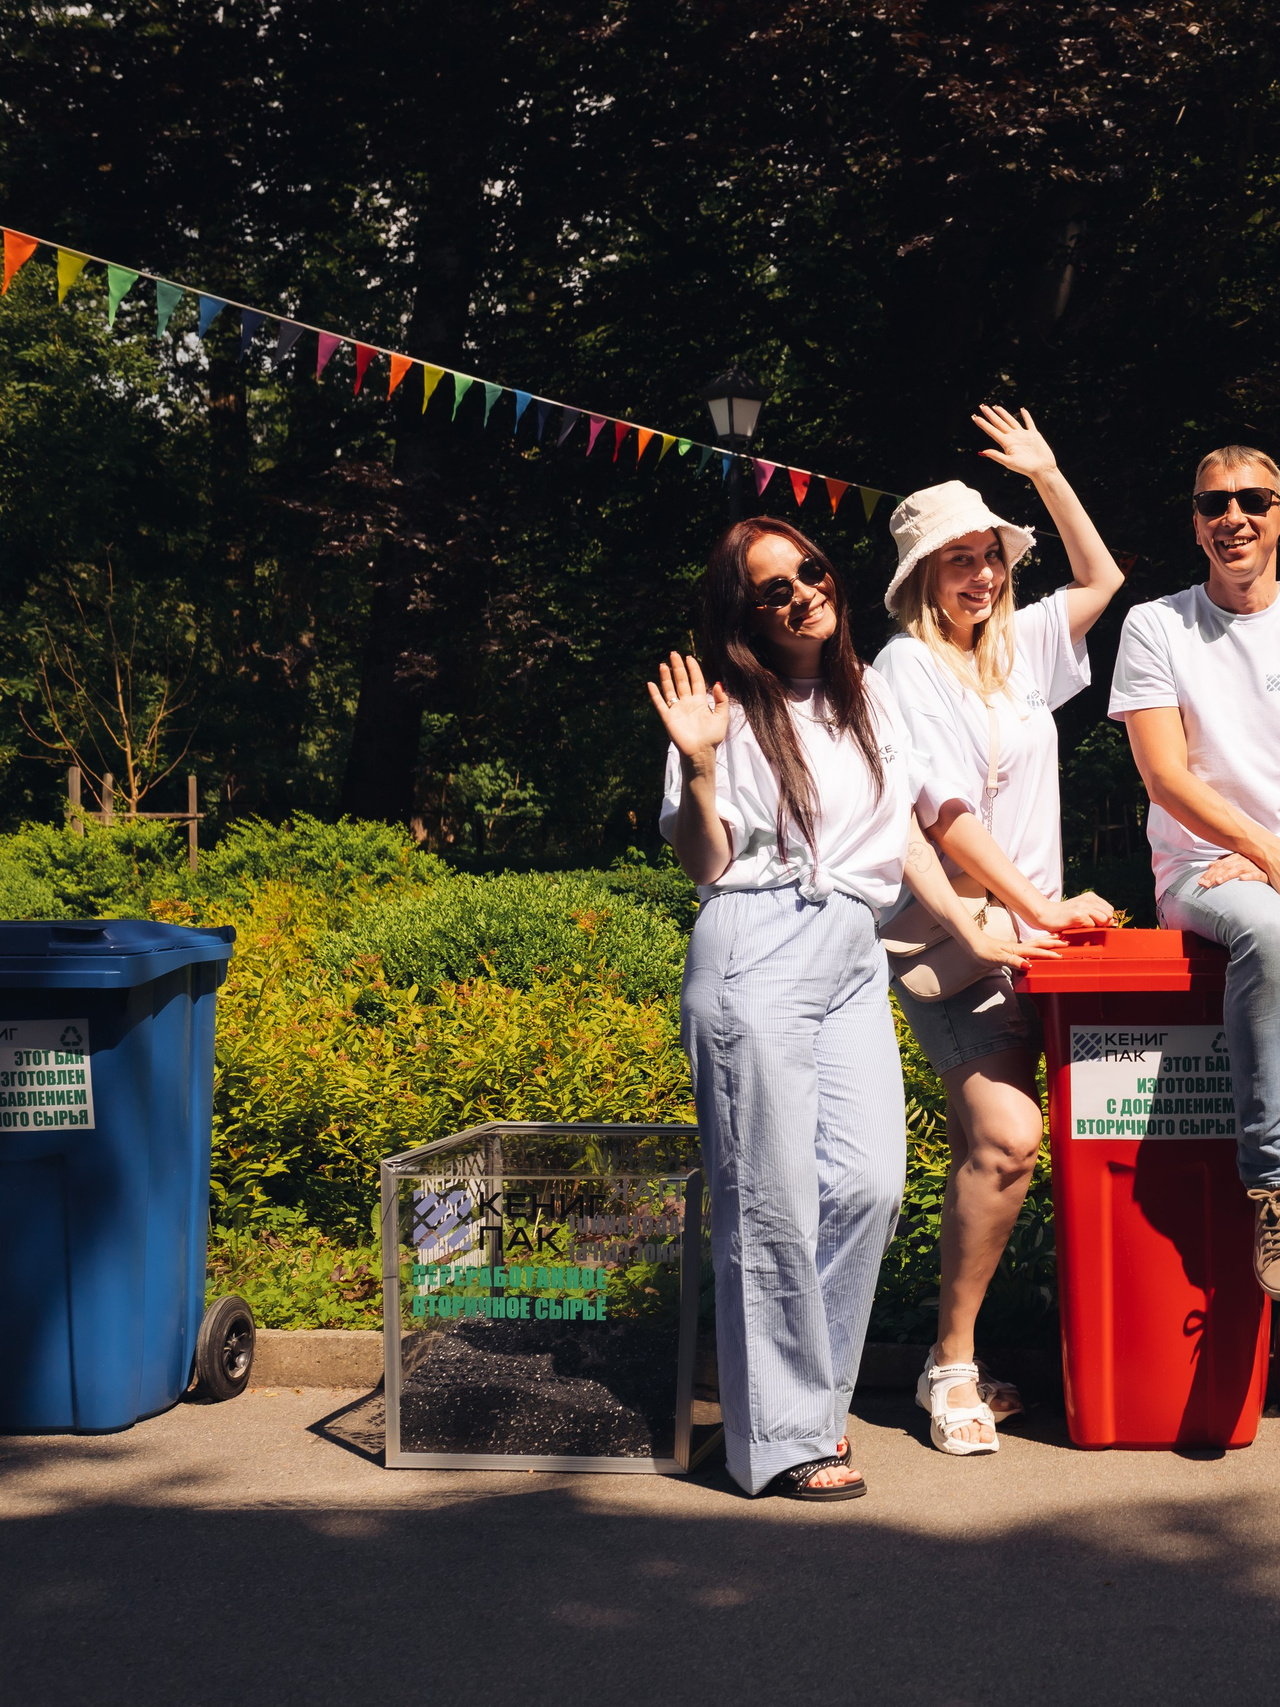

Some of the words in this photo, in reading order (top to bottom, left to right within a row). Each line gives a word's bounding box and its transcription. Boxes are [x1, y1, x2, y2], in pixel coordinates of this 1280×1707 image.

[1105, 1033, 1169, 1046] КЕНИГ
[14, 1050, 51, 1066] ЭТОТ
[54, 1049, 85, 1065] БАК
[1105, 1050, 1146, 1062] ПАК
[1163, 1056, 1201, 1072] ЭТОТ
[0, 1069, 86, 1087] ЗГОТОВЛЕН
[1137, 1077, 1233, 1094] ИЗГОТОВЛЕН
[0, 1090, 87, 1107] БАВЛЕНИЕМ
[1107, 1098, 1117, 1114] С
[1120, 1097, 1236, 1116] ДОБАВЛЕНИЕМ
[33, 1110, 89, 1126] СЫРЬЯ
[1077, 1119, 1176, 1135] ВТОРИЧНОГО
[1180, 1119, 1236, 1135] СЫРЬЯ
[479, 1192, 606, 1219] КЕНИГ
[479, 1226, 562, 1252] ПАК
[413, 1264, 606, 1290] ПЕРЕРАБОТАННОЕ
[413, 1295, 531, 1320] ВТОРИЧНОЕ
